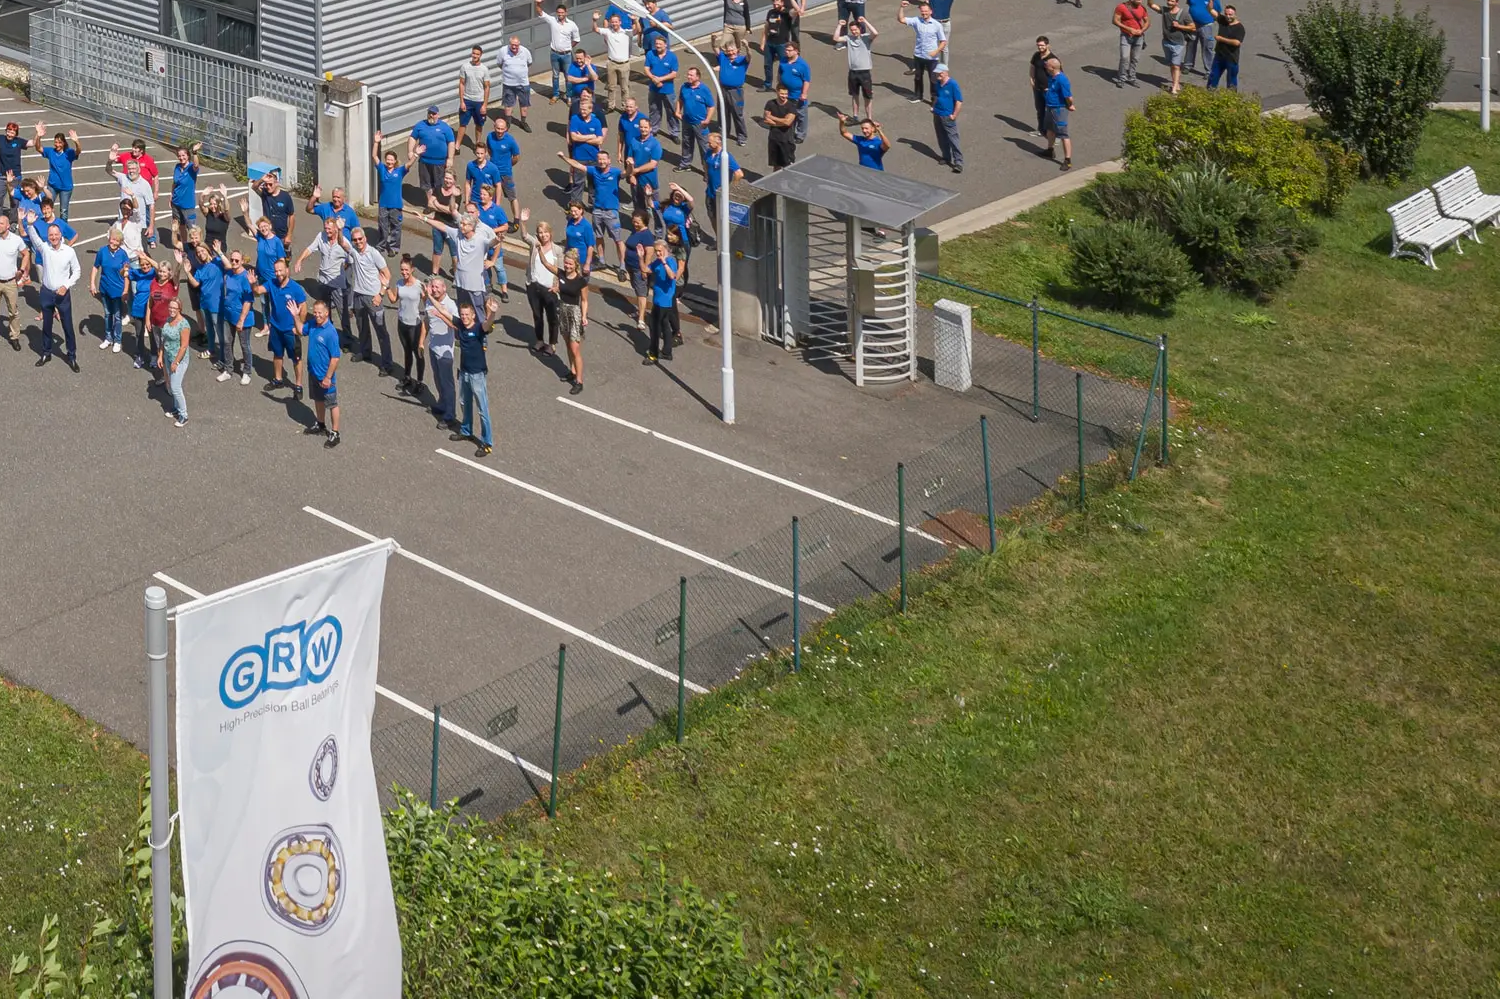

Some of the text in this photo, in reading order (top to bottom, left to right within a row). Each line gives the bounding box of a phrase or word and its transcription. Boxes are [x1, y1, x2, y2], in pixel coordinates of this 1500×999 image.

[229, 628, 336, 697] GRW
[219, 679, 339, 733] High-Precision Ball Bearings
